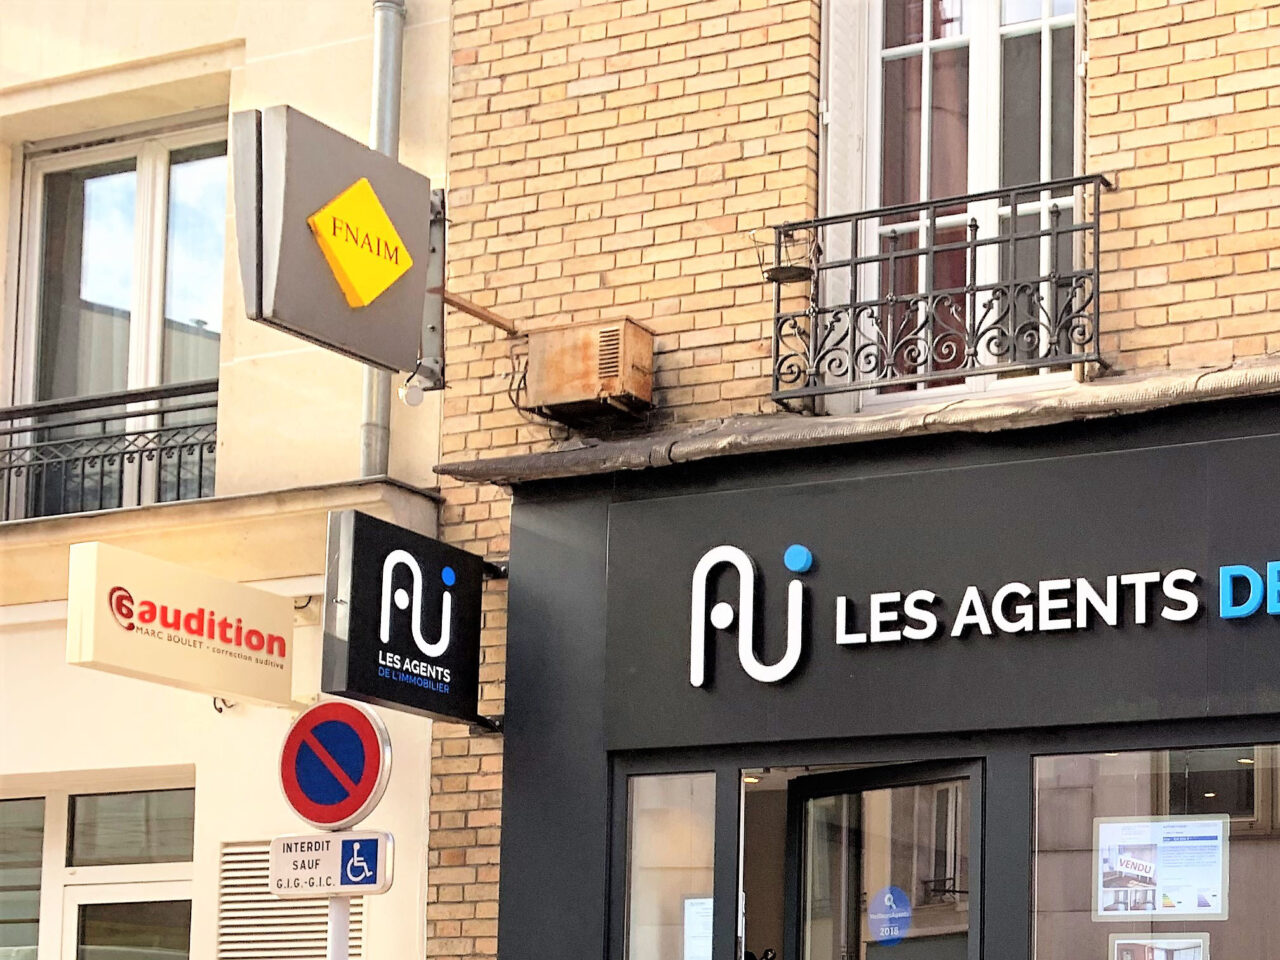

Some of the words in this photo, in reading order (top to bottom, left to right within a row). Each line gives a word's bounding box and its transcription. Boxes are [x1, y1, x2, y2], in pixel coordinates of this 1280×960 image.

[331, 215, 399, 265] FNAIM
[835, 588, 938, 645] LES
[950, 567, 1200, 638] AGENTS
[135, 625, 164, 641] MARC
[166, 632, 205, 650] BOULET
[211, 645, 254, 663] correction
[254, 655, 285, 671] auditive
[378, 649, 402, 670] LES
[402, 657, 452, 683] AGENTS
[378, 666, 391, 678] DE
[391, 669, 451, 695] L'IMMOBILIER
[282, 840, 331, 854] INTERDIT
[292, 858, 321, 871] SAUF
[1119, 858, 1152, 874] VENDU
[879, 926, 900, 937] 2018
